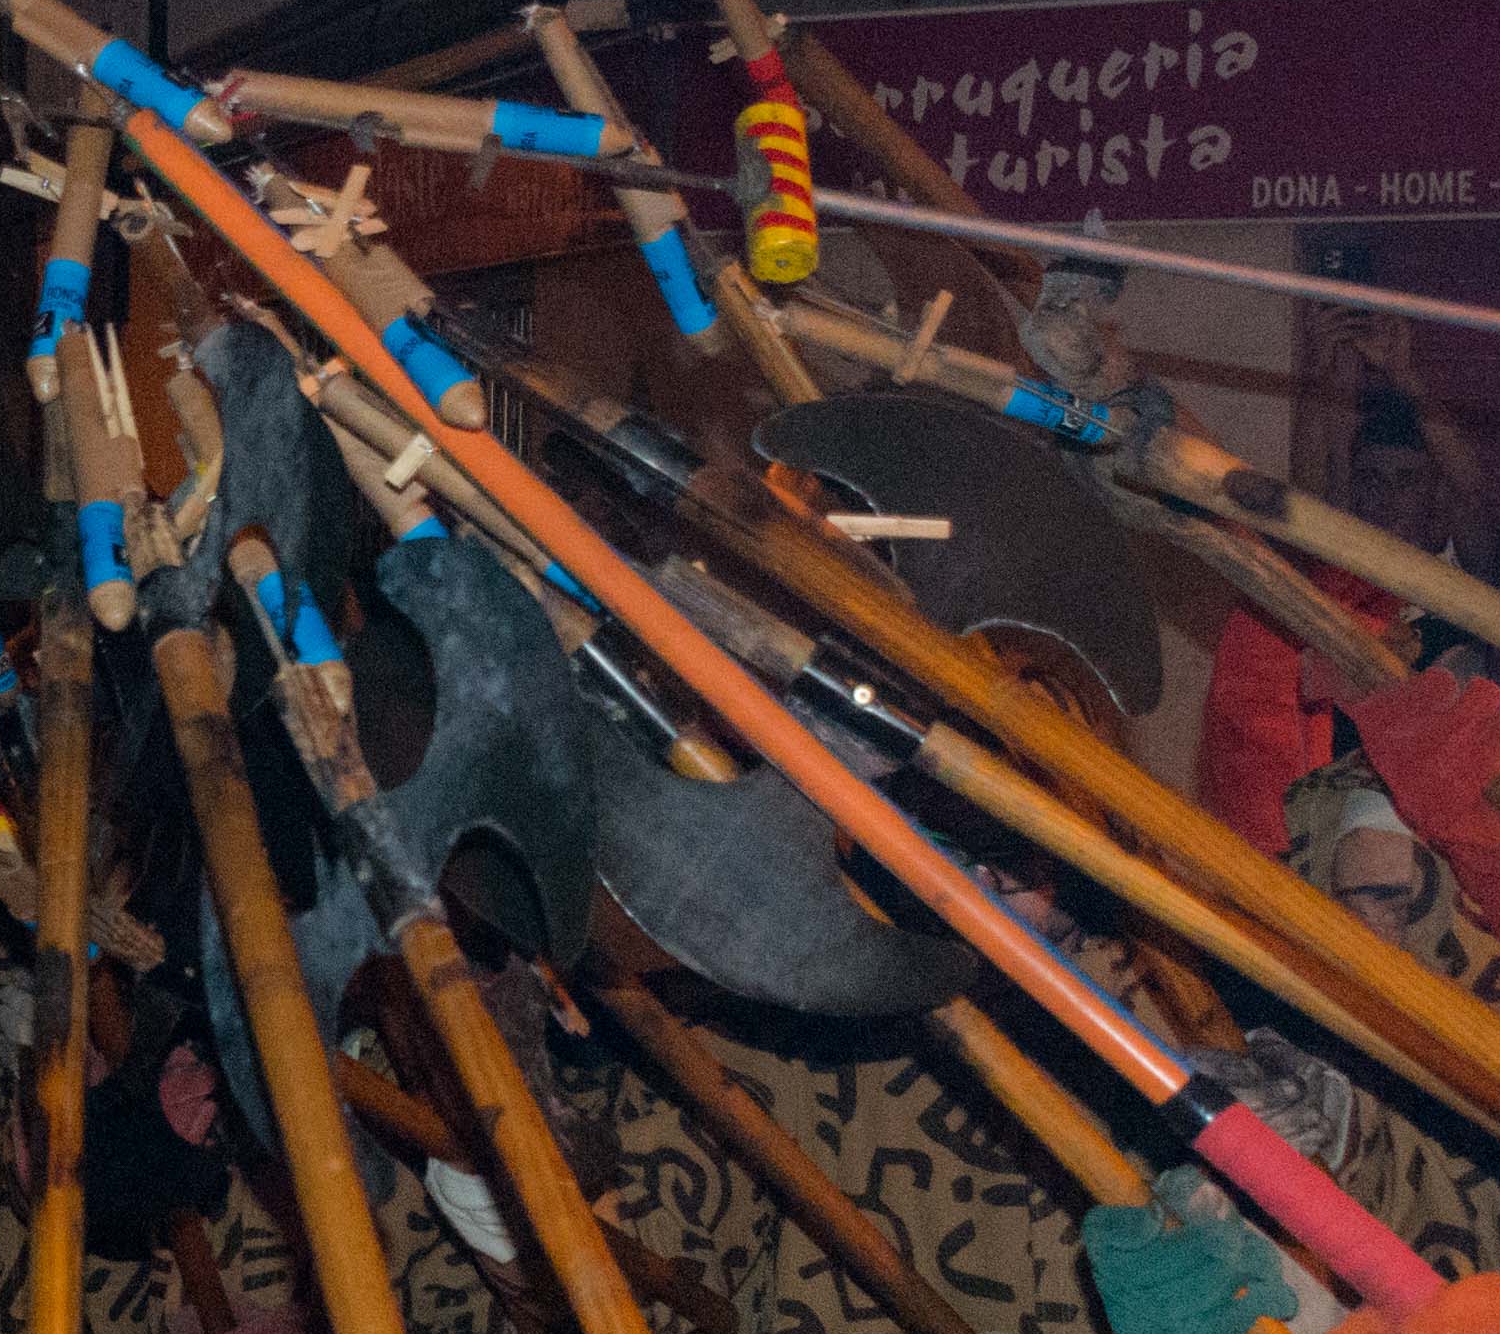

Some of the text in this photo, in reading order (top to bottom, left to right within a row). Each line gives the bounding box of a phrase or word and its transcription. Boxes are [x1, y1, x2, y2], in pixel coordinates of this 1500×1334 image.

[806, 8, 1259, 138] rruqueria
[1251, 173, 1342, 209] DONA
[1380, 169, 1476, 205] HOME
